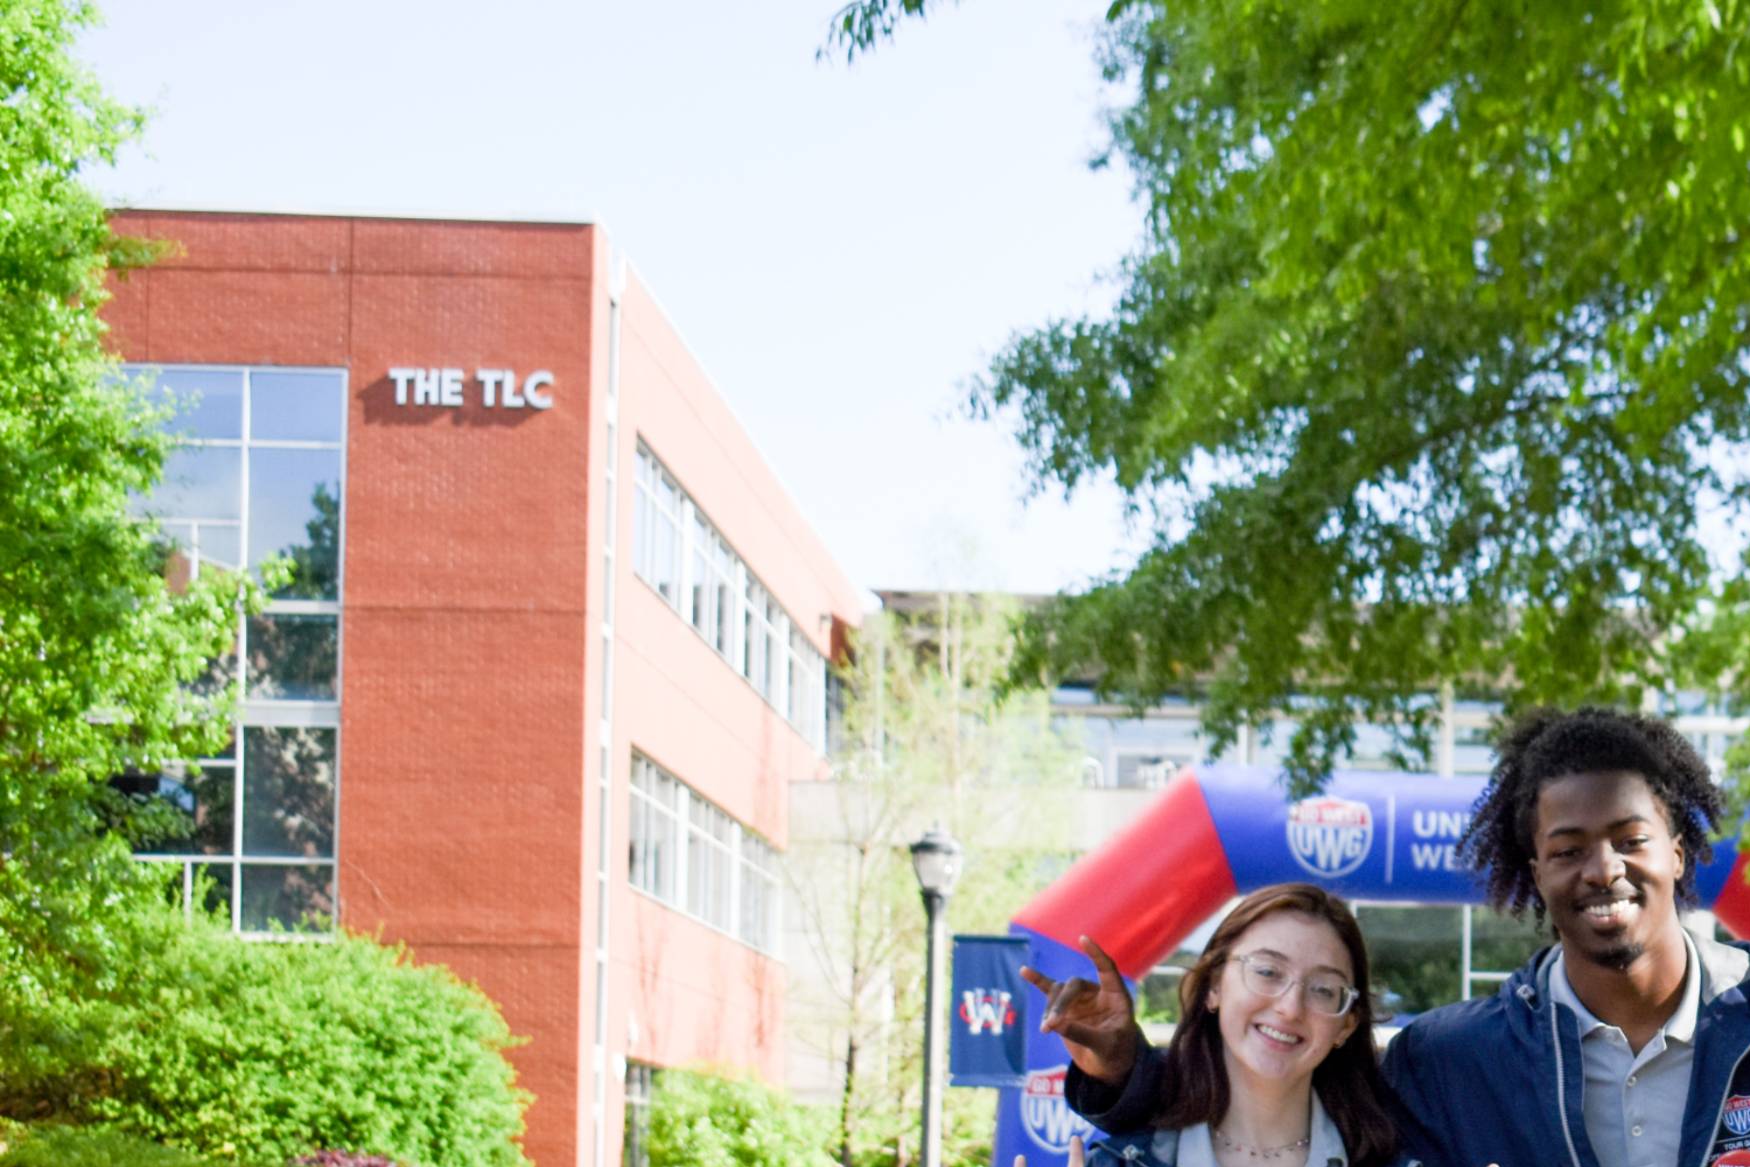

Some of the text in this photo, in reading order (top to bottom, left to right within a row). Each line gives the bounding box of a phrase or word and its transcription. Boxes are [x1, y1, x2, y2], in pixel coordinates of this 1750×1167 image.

[388, 367, 554, 409] THE TLC
[1294, 826, 1365, 869] UWG
[1410, 844, 1458, 871] WE
